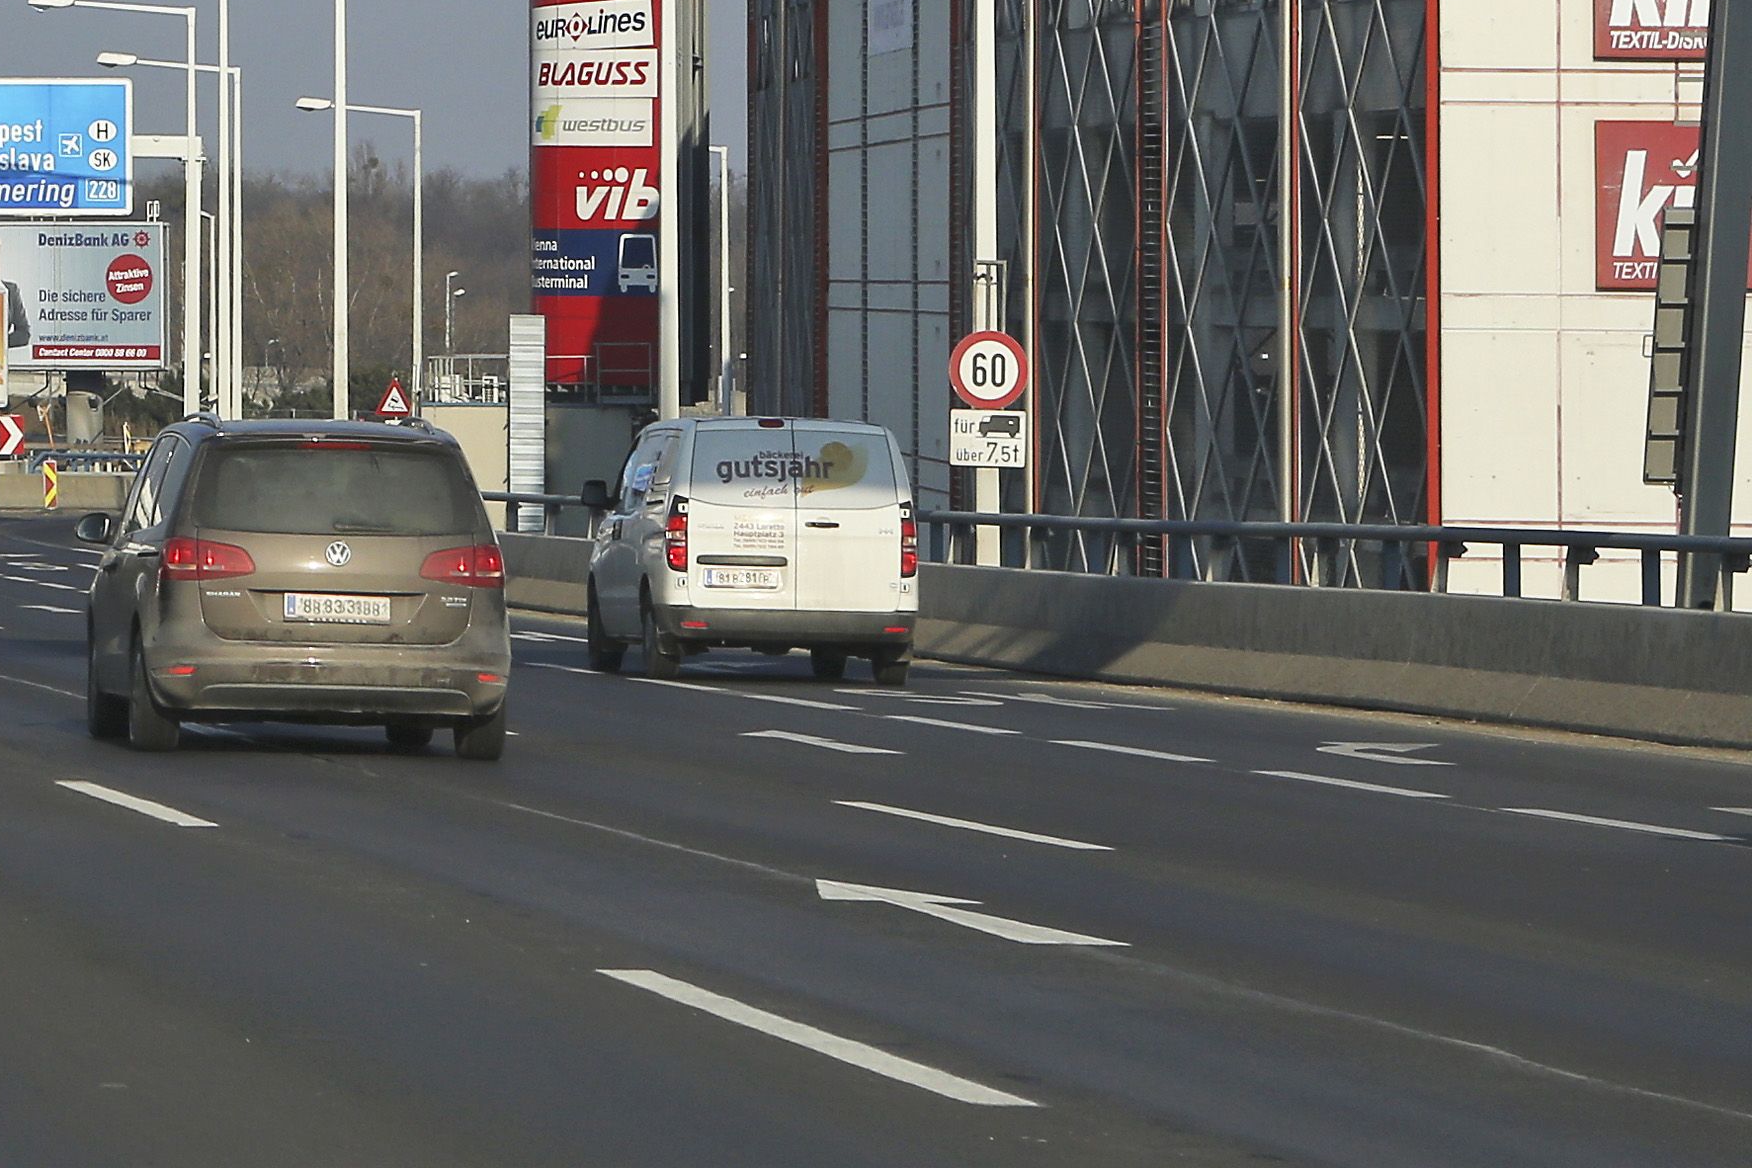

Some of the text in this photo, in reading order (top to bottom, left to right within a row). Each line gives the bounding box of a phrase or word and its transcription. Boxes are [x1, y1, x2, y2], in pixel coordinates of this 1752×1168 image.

[538, 61, 650, 86] BLAGUSS
[96, 123, 108, 138] H
[562, 118, 646, 133] westbus
[93, 152, 112, 168] SK
[88, 180, 118, 202] 228
[575, 167, 660, 221] vib
[38, 232, 129, 247] DenizBank AG
[108, 268, 150, 281] Attraktive
[38, 289, 107, 303] Die sichere
[115, 282, 145, 294] Zinsen
[38, 308, 152, 324] Adresse für Sparer
[69, 348, 94, 357] Center
[972, 352, 1006, 387] 60
[954, 417, 976, 434] für
[956, 442, 1019, 464] über 7,5t
[716, 454, 835, 484] gutsjahr
